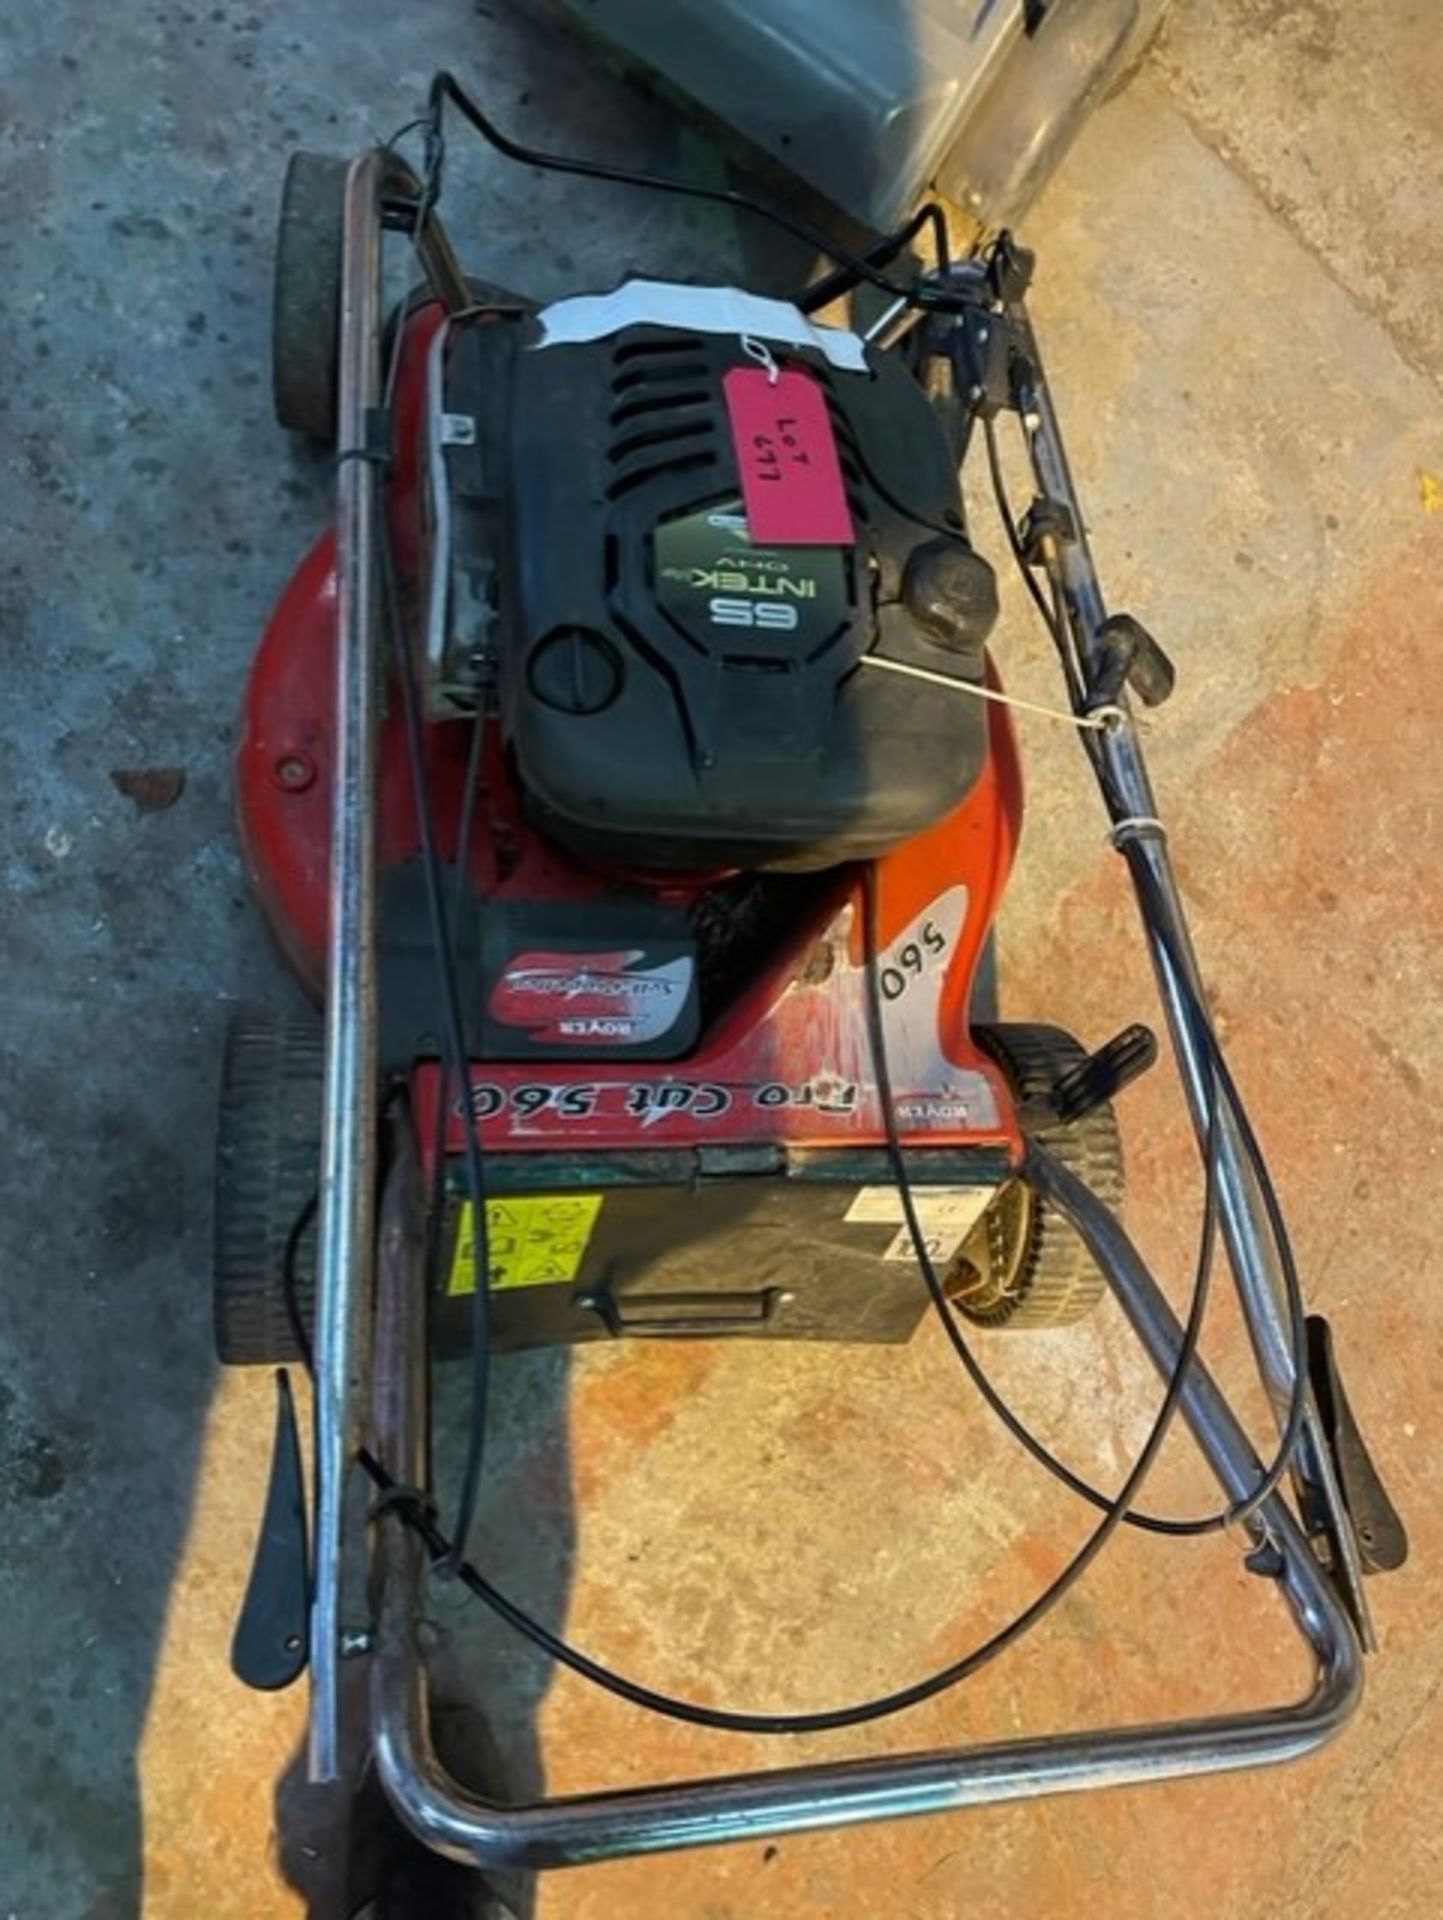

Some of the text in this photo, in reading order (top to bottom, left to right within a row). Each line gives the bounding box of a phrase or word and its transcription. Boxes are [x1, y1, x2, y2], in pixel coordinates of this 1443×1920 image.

[691, 569, 816, 598] INTEK
[709, 598, 798, 630] 65
[881, 921, 946, 1001] 560
[559, 1021, 633, 1036] ROVER
[458, 1083, 598, 1120] 560
[626, 1083, 732, 1118] Cut
